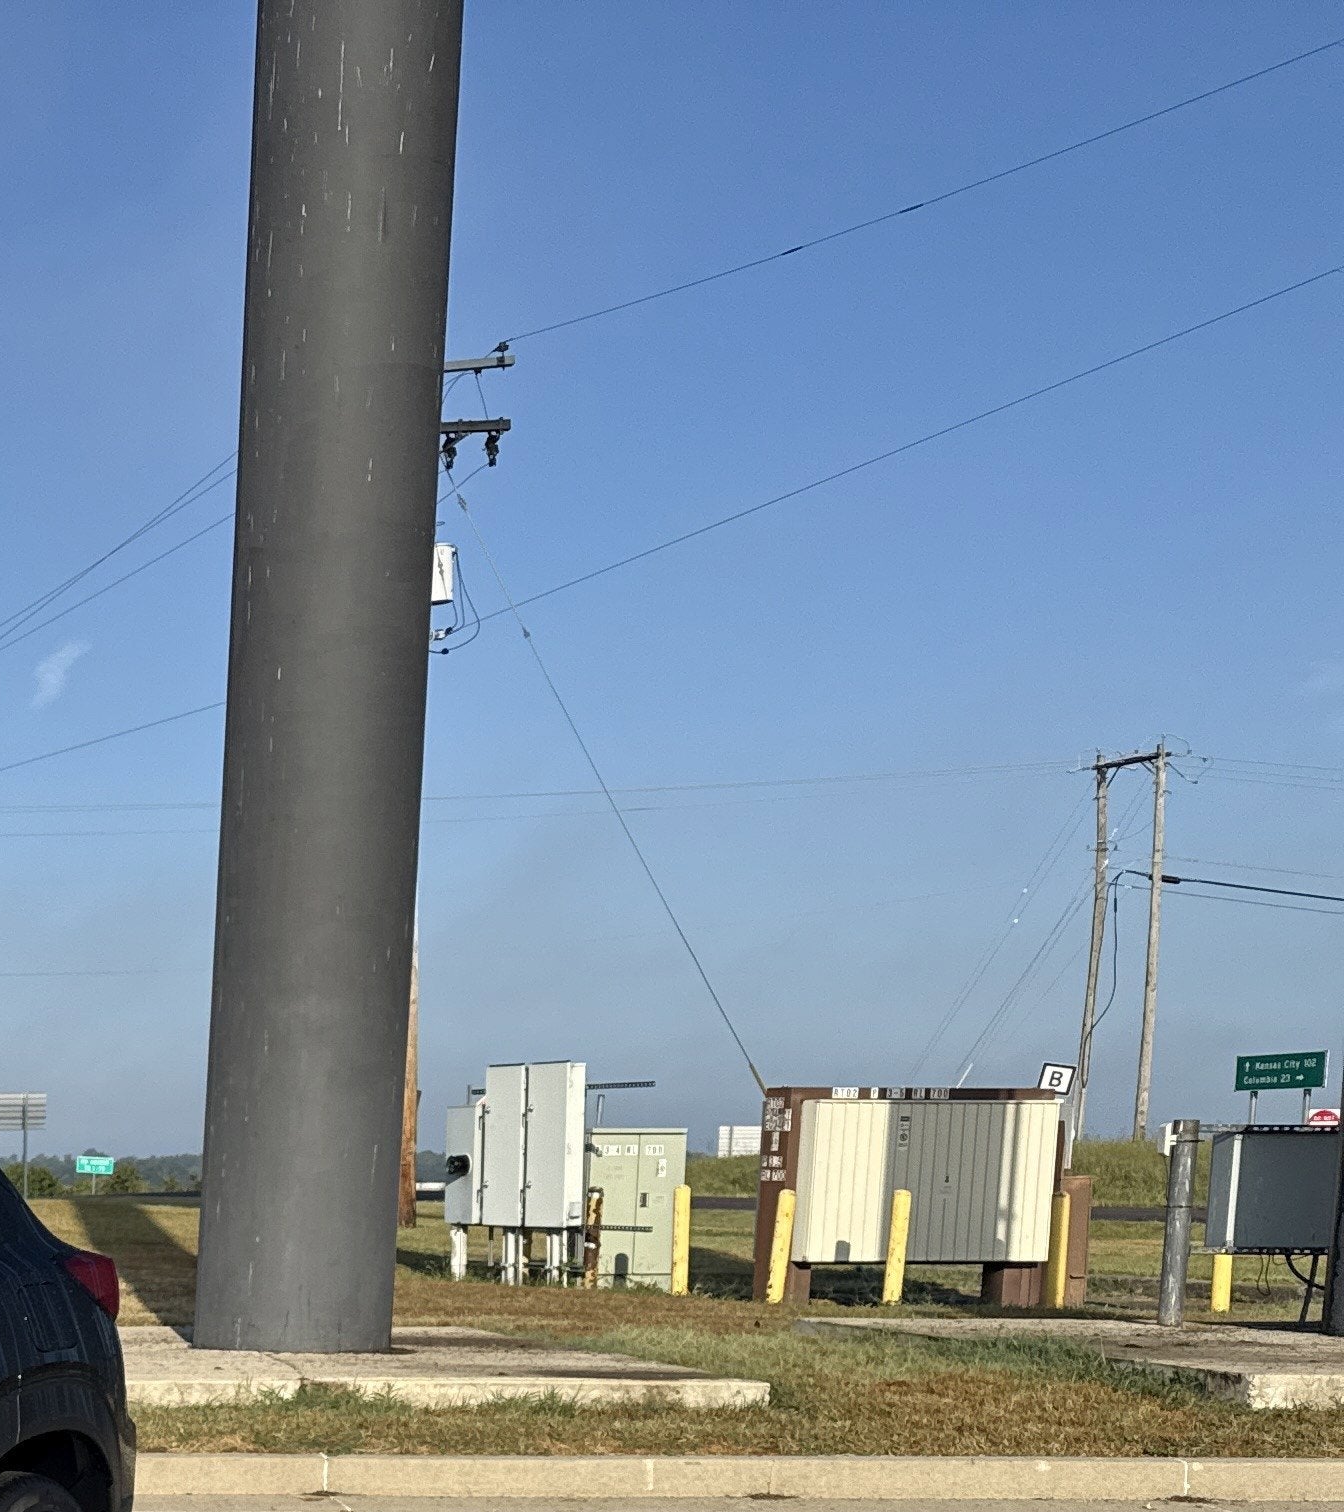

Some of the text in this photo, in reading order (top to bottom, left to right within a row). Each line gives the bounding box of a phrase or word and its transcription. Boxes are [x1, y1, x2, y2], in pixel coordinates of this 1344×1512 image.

[1255, 1061, 1282, 1071] Kansas
[1284, 1060, 1301, 1071] City
[1048, 1070, 1064, 1087] B
[1243, 1073, 1291, 1085] Columbia 23
